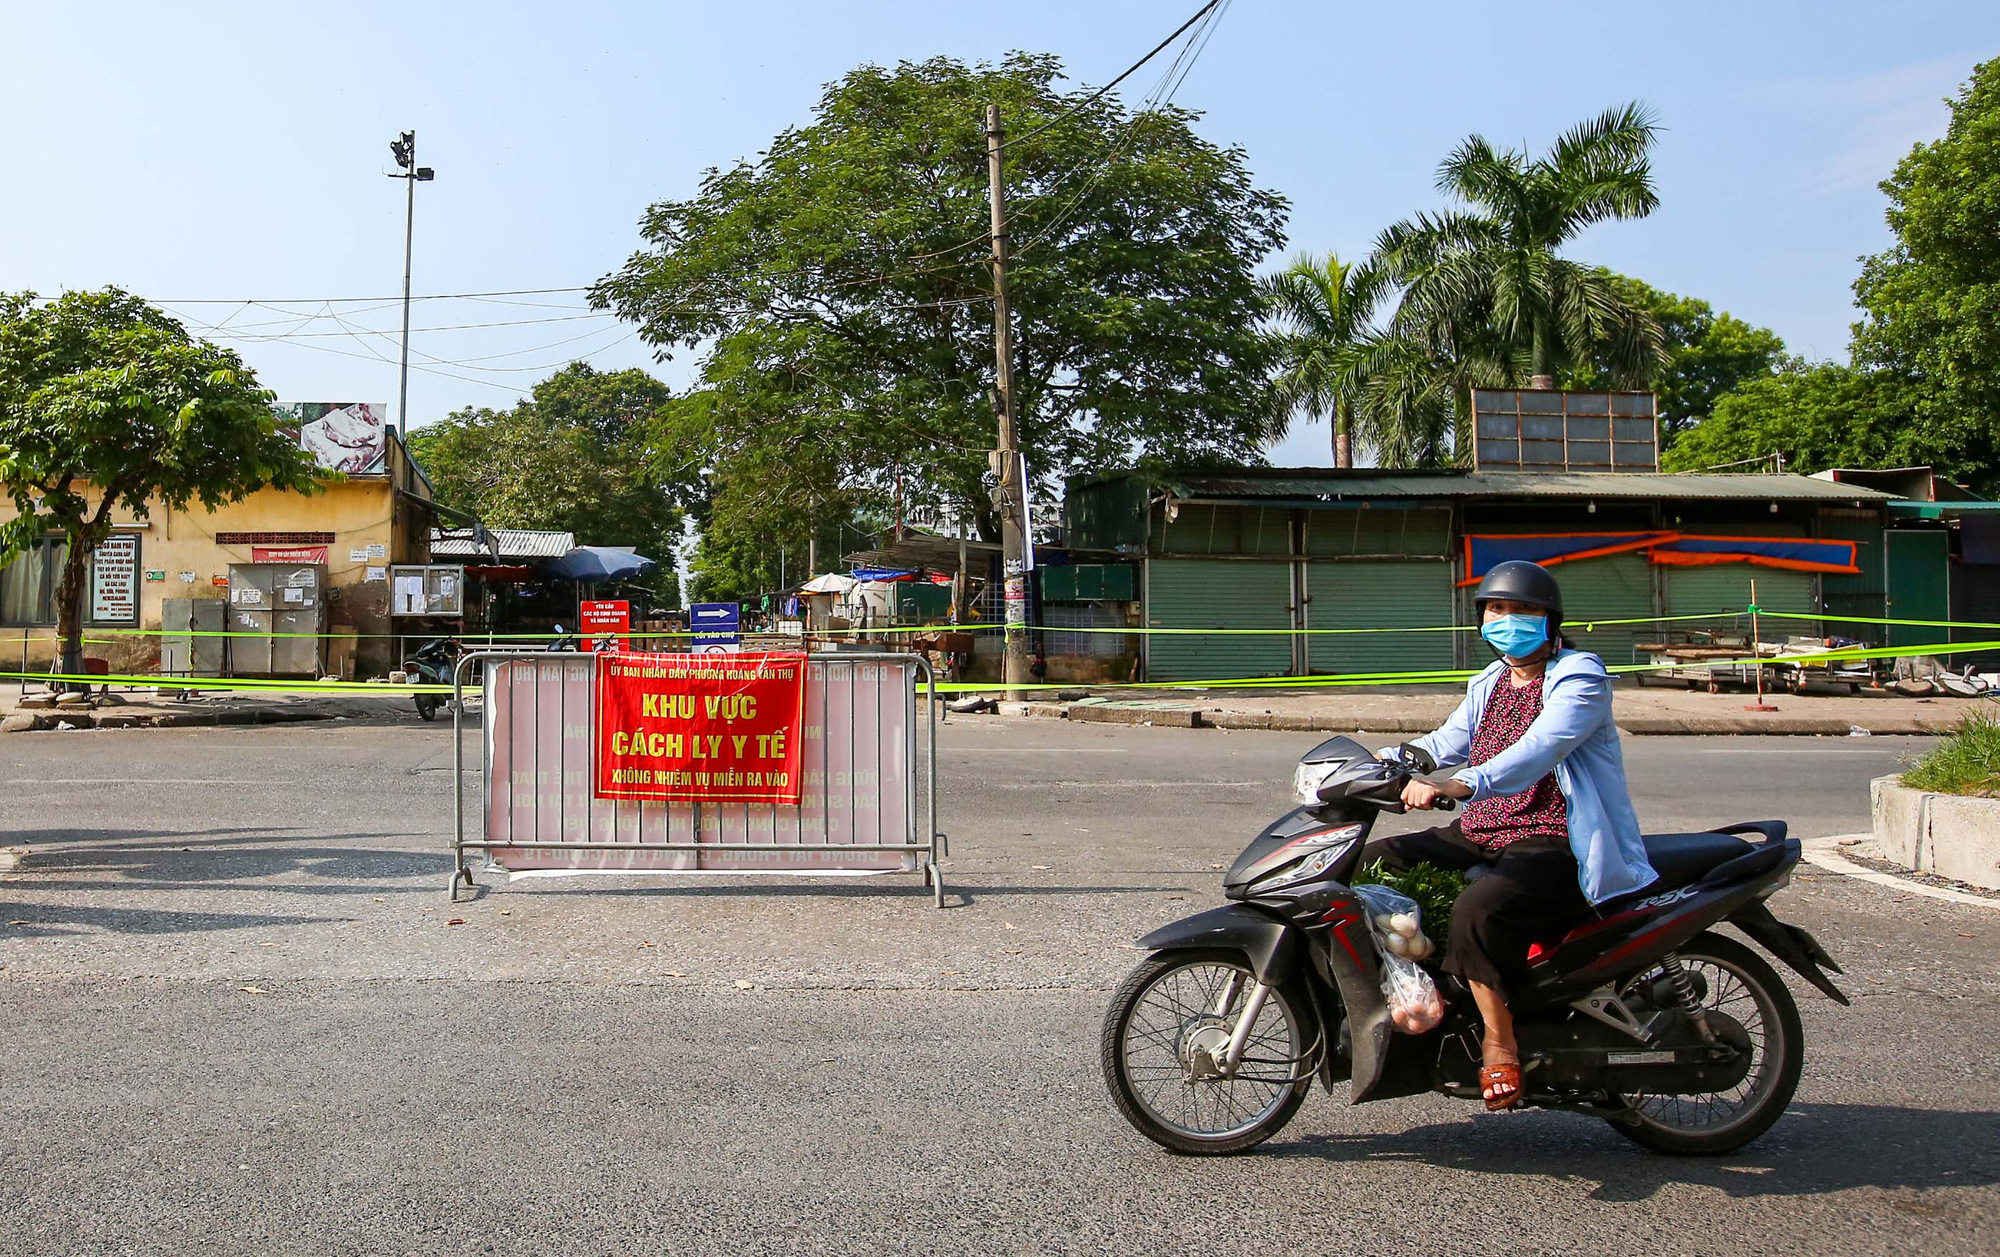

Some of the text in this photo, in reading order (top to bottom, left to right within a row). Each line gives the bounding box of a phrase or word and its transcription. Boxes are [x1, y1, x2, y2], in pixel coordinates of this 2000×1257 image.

[610, 661, 622, 676] ỦY
[623, 666, 640, 678] BAN
[642, 665, 667, 679] NHÂN
[689, 666, 724, 680] PHƯỜNG
[777, 669, 794, 682] THỤ
[642, 693, 757, 724] KHU VỰC
[612, 726, 683, 758] CÁCH
[692, 735, 721, 758] LY
[731, 735, 748, 758] Y
[755, 725, 789, 759] TẾ
[612, 766, 789, 789] KHÔNG NHIỆM VỤ MIỄN RA VÀO
